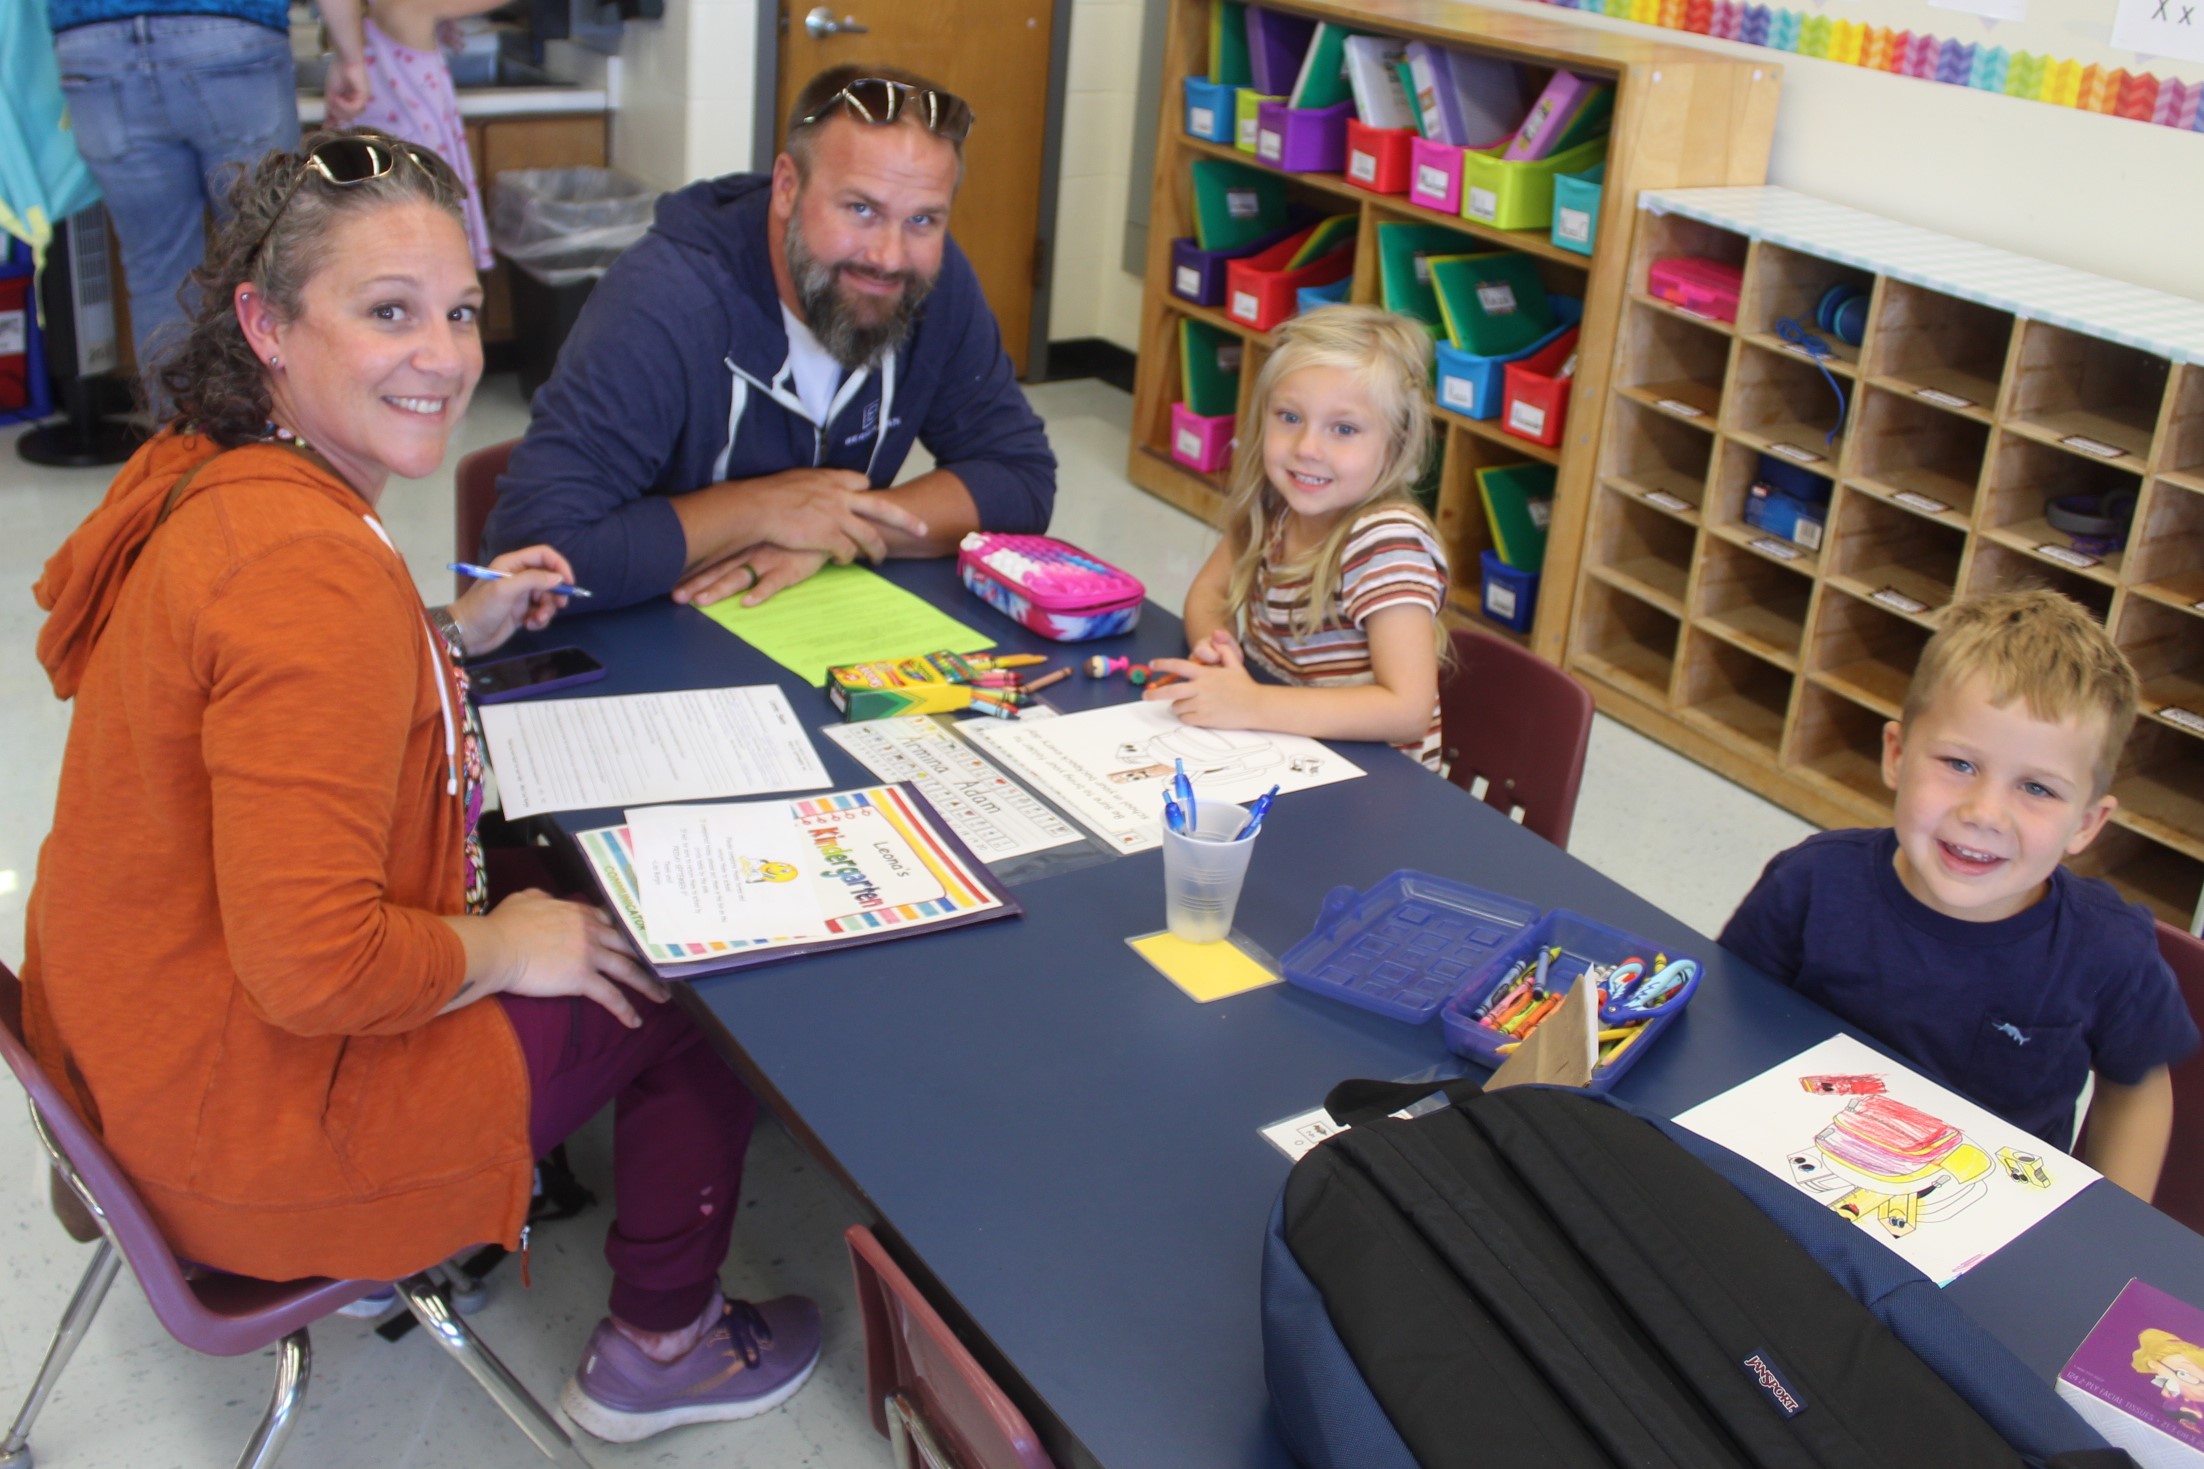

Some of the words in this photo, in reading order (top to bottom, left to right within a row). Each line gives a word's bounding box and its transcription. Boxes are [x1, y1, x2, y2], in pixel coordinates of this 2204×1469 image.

[953, 780, 1000, 814] Adam
[808, 827, 883, 908] Kindergarten
[873, 841, 911, 877] Leona's
[2099, 1387, 2124, 1405] FACIAL
[2126, 1401, 2155, 1422] TISSUES
